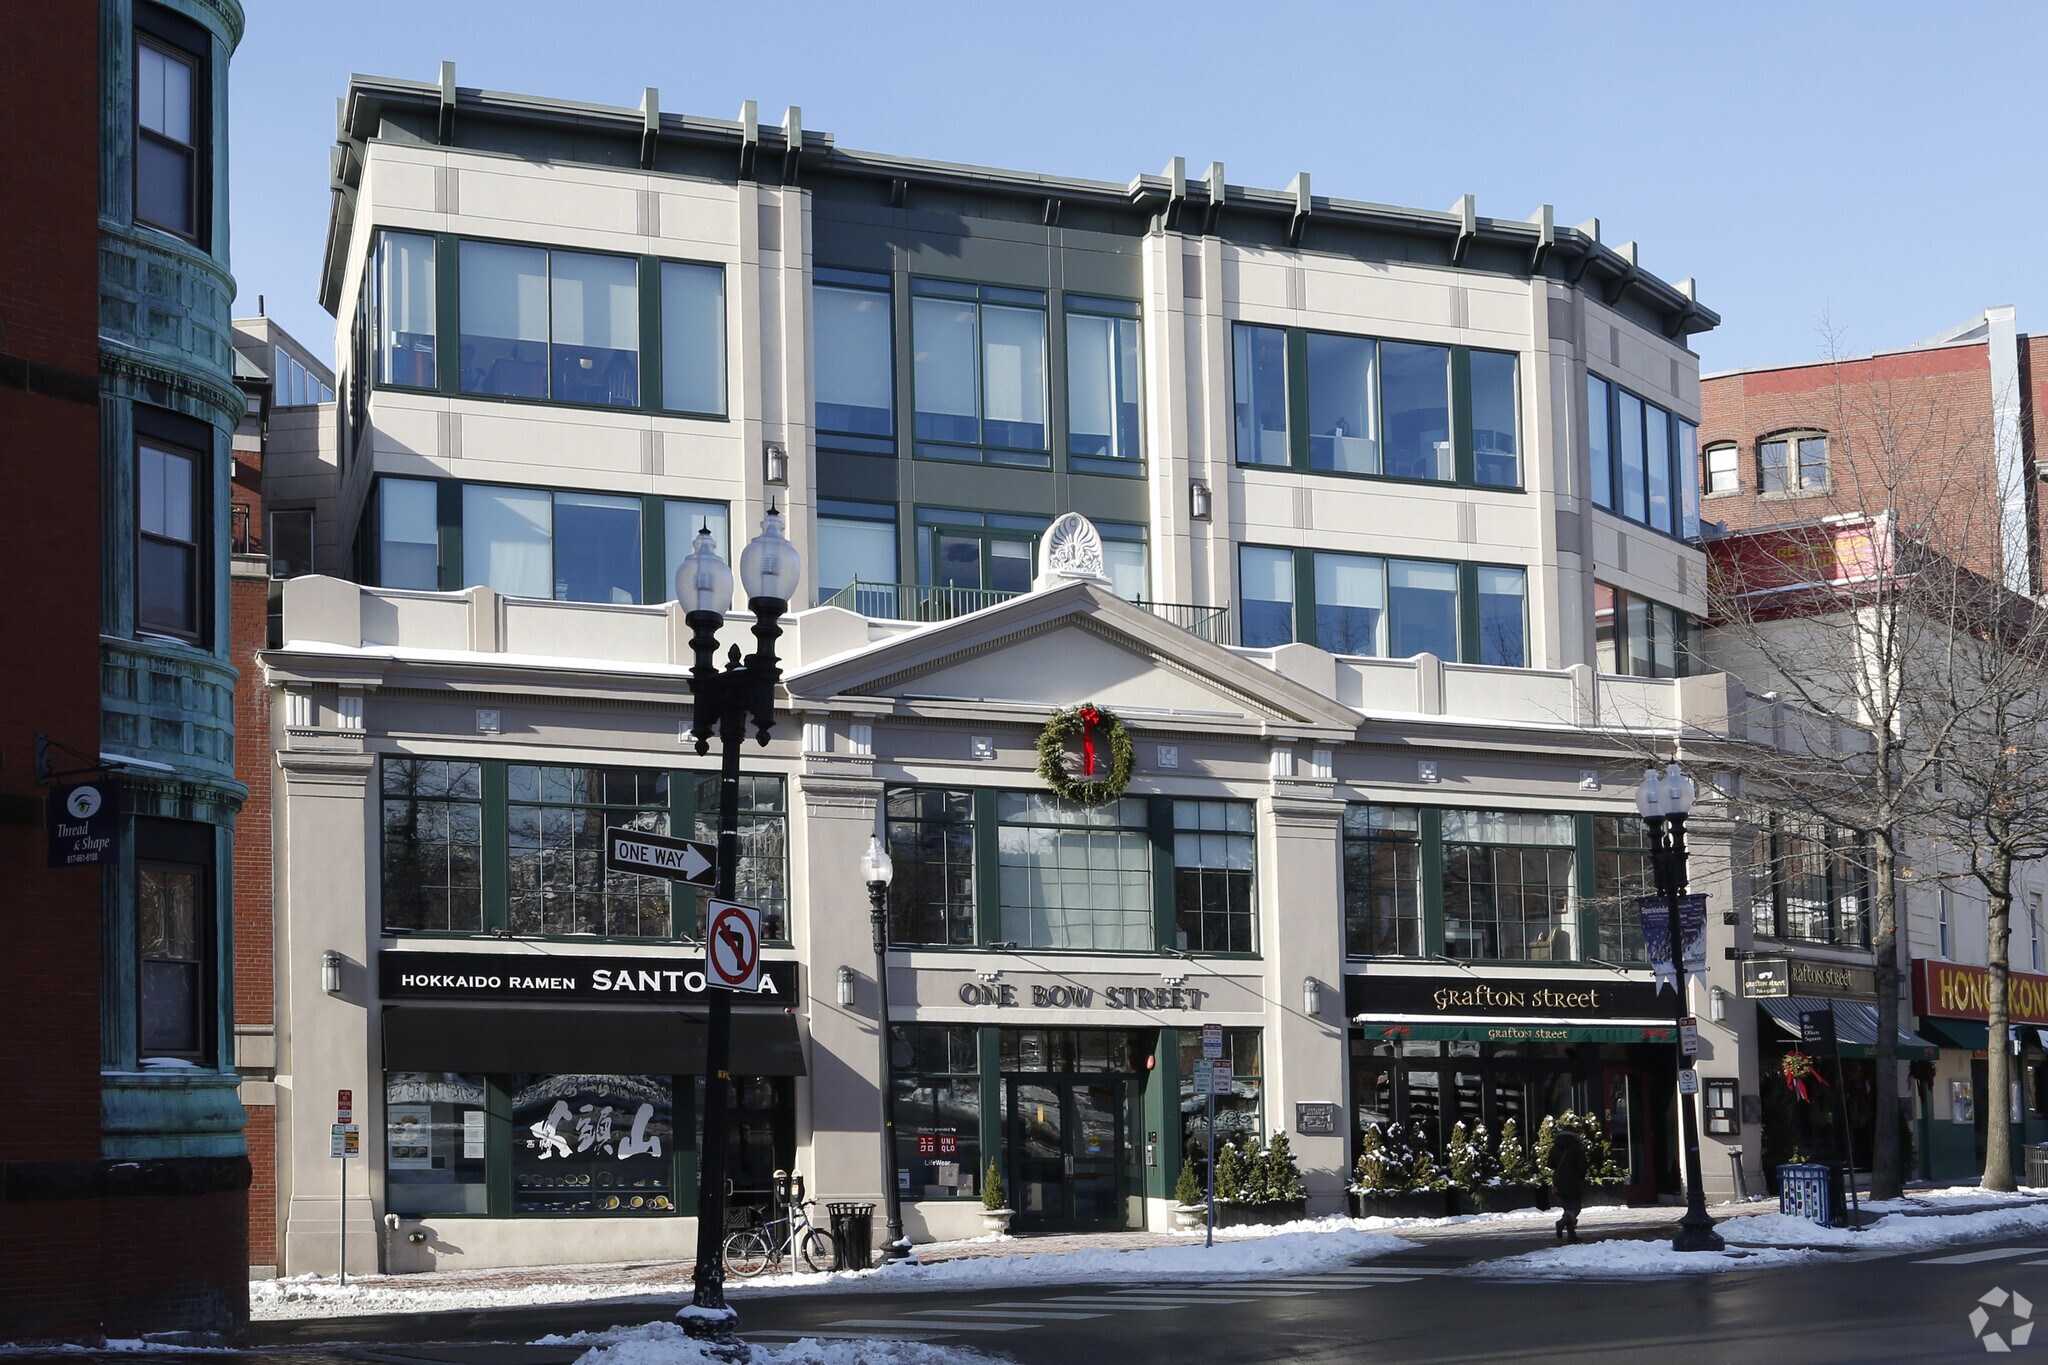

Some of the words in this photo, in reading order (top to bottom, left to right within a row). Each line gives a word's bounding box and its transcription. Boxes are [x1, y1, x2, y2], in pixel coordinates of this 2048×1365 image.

[57, 821, 89, 837] Thread
[73, 840, 80, 851] &
[82, 836, 110, 852] Shape
[620, 843, 649, 862] ONE
[655, 848, 685, 868] WAY
[402, 974, 501, 988] HOKKAIDO
[509, 977, 575, 990] RAMEN
[592, 969, 779, 994] SANTOA
[960, 983, 1013, 1005] ONE
[1031, 985, 1090, 1007] BOW
[1106, 986, 1202, 1010] STREET
[2008, 977, 2048, 1018] KON
[941, 1145, 955, 1153] QLO
